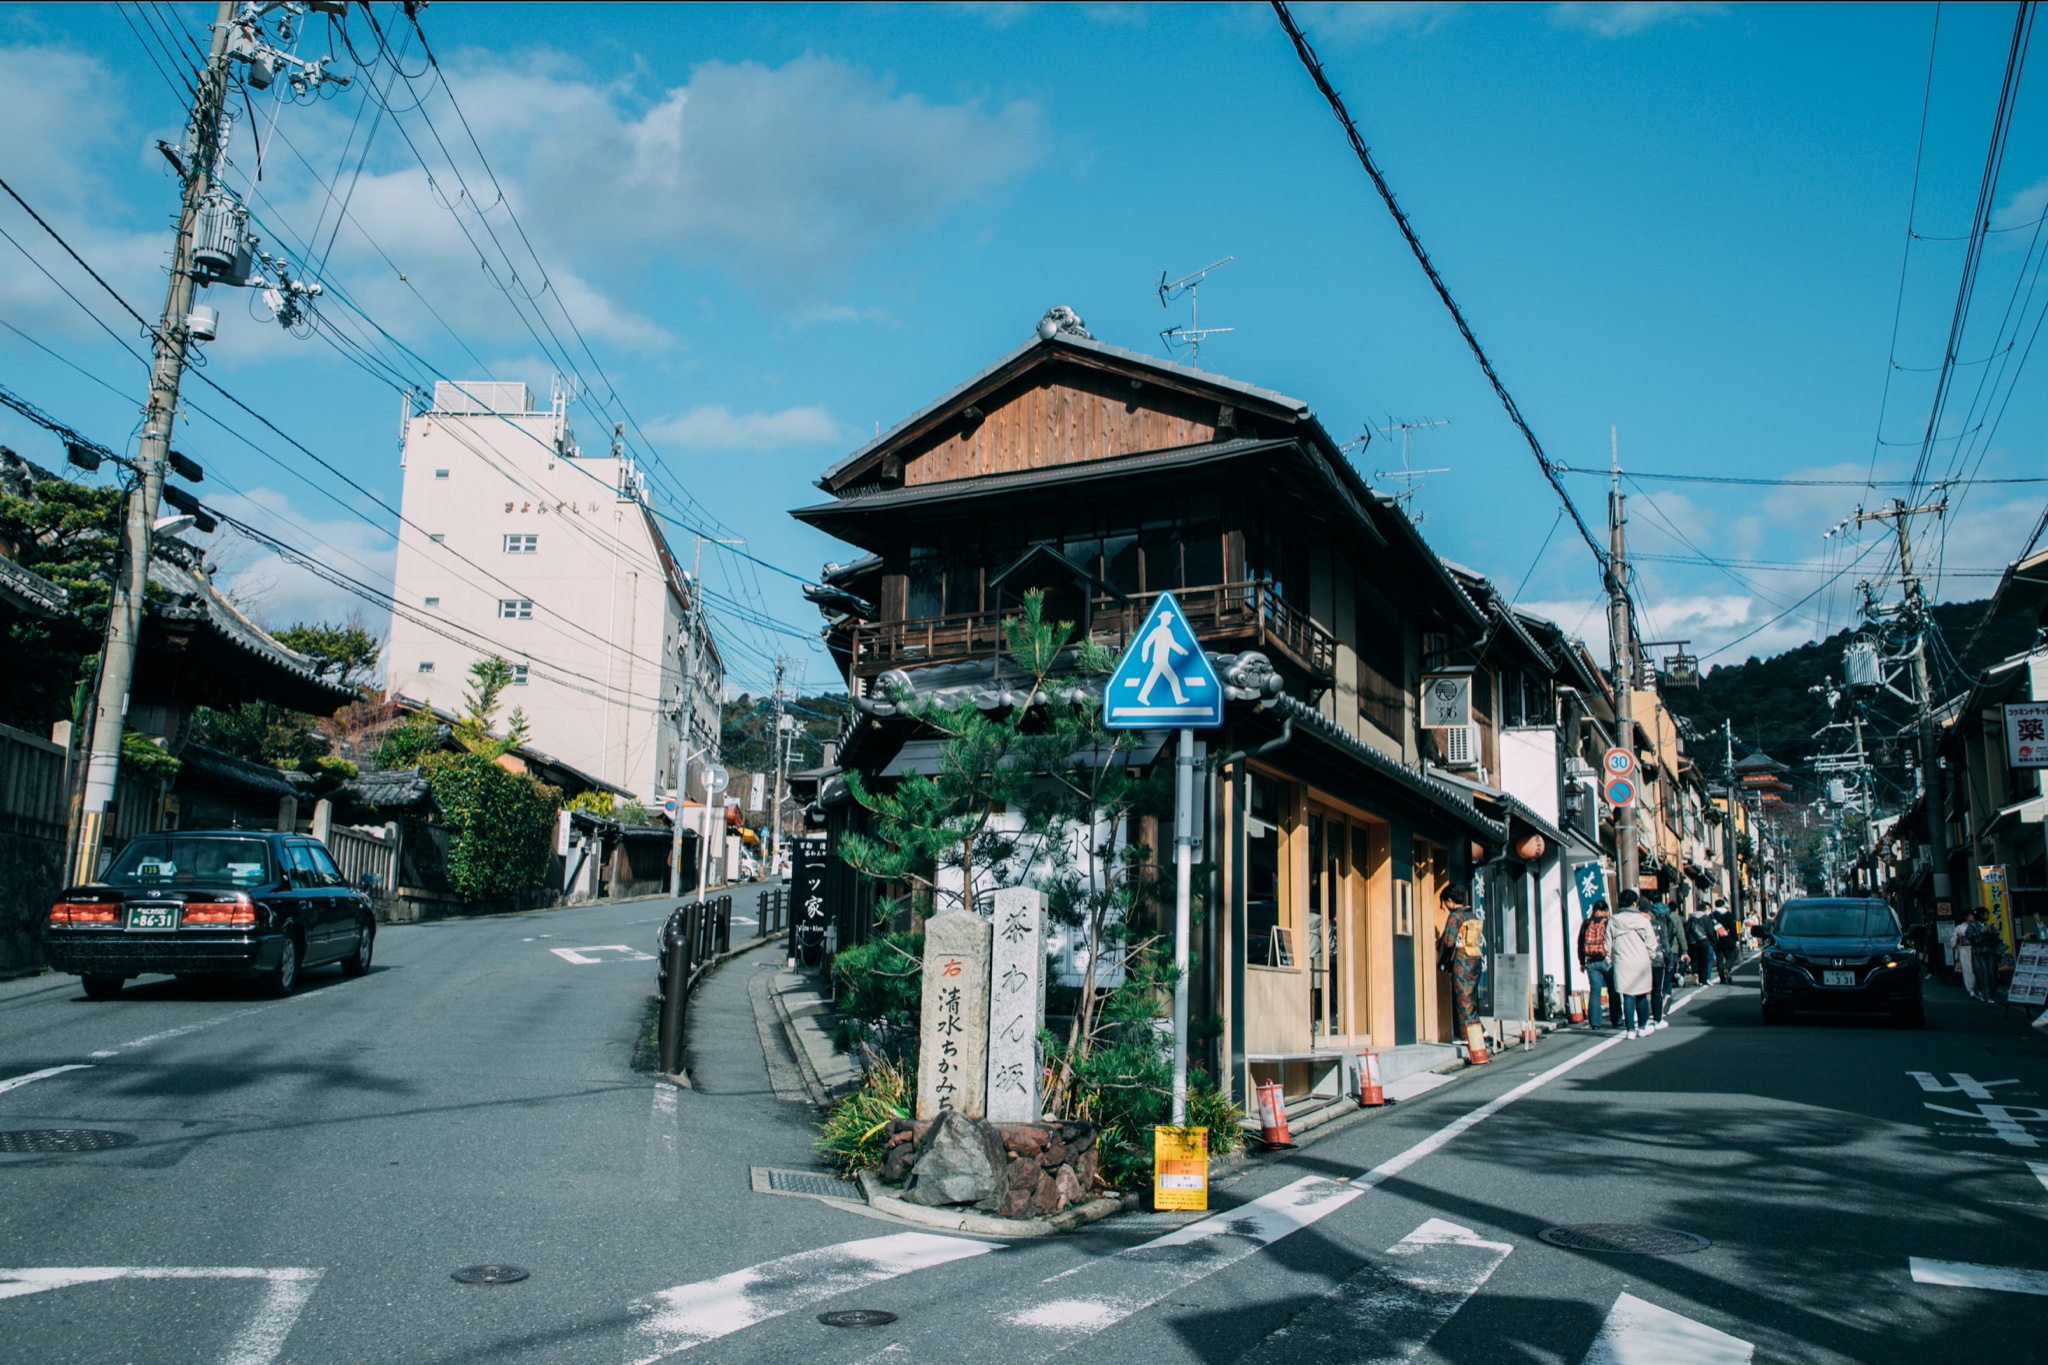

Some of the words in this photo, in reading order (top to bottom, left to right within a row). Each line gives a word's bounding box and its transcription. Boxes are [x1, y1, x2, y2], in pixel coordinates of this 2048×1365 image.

[2017, 718, 2045, 742] 薬
[1611, 756, 1628, 769] 30
[144, 866, 157, 874] 135
[804, 863, 825, 919] 一ツ家
[139, 915, 172, 927] 86-31
[941, 958, 962, 977] 右
[936, 985, 963, 1111] 清水ちかみち
